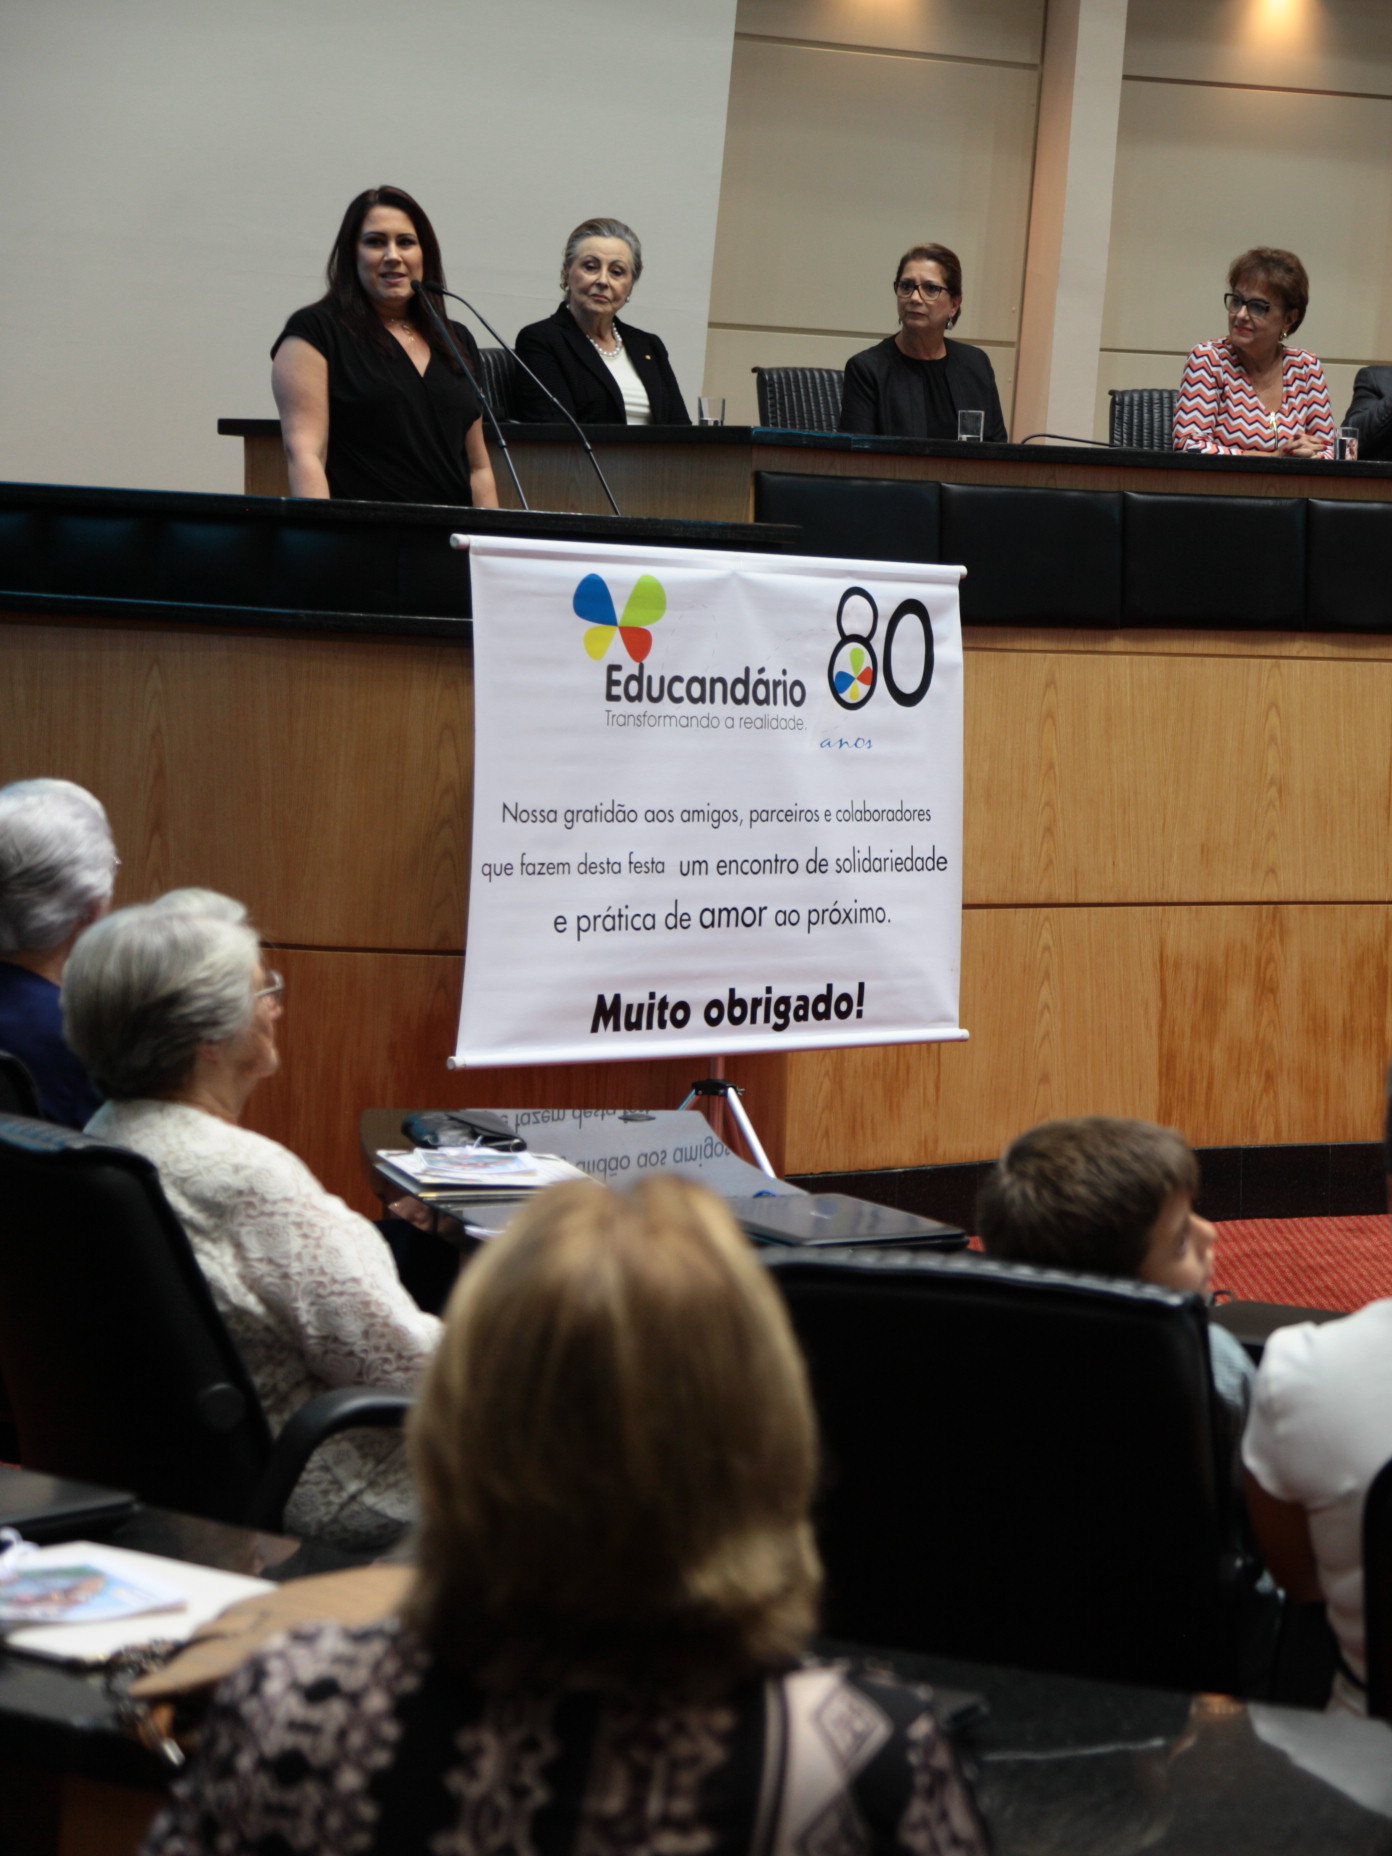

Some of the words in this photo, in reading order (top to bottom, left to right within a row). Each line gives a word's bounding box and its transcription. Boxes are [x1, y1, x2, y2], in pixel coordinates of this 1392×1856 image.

[827, 586, 935, 711] 80
[604, 664, 807, 708] Educandário
[604, 709, 721, 729] Transformando
[724, 716, 735, 730] a
[739, 713, 807, 731] realidade.
[819, 736, 873, 750] anos
[501, 801, 558, 824] Nossa
[563, 798, 639, 831] gratidão
[643, 808, 675, 824] aos
[679, 802, 744, 830] amigos,
[749, 802, 820, 830] parceiros
[823, 808, 832, 823] e
[835, 799, 932, 823] colaboradores
[481, 859, 515, 884] que
[519, 851, 571, 877] fazem
[576, 851, 622, 876] desta
[627, 850, 666, 875] festa
[679, 859, 709, 877] um
[715, 854, 800, 877] encontro
[805, 846, 829, 875] de
[834, 844, 949, 875] solidariedade
[552, 914, 568, 934] e
[576, 903, 657, 943] prática
[664, 899, 692, 931] de
[698, 905, 769, 930] amor
[774, 908, 801, 928] ao
[807, 898, 892, 935] próximo.
[590, 990, 691, 1034] Muito
[702, 981, 866, 1033] obrigado!
